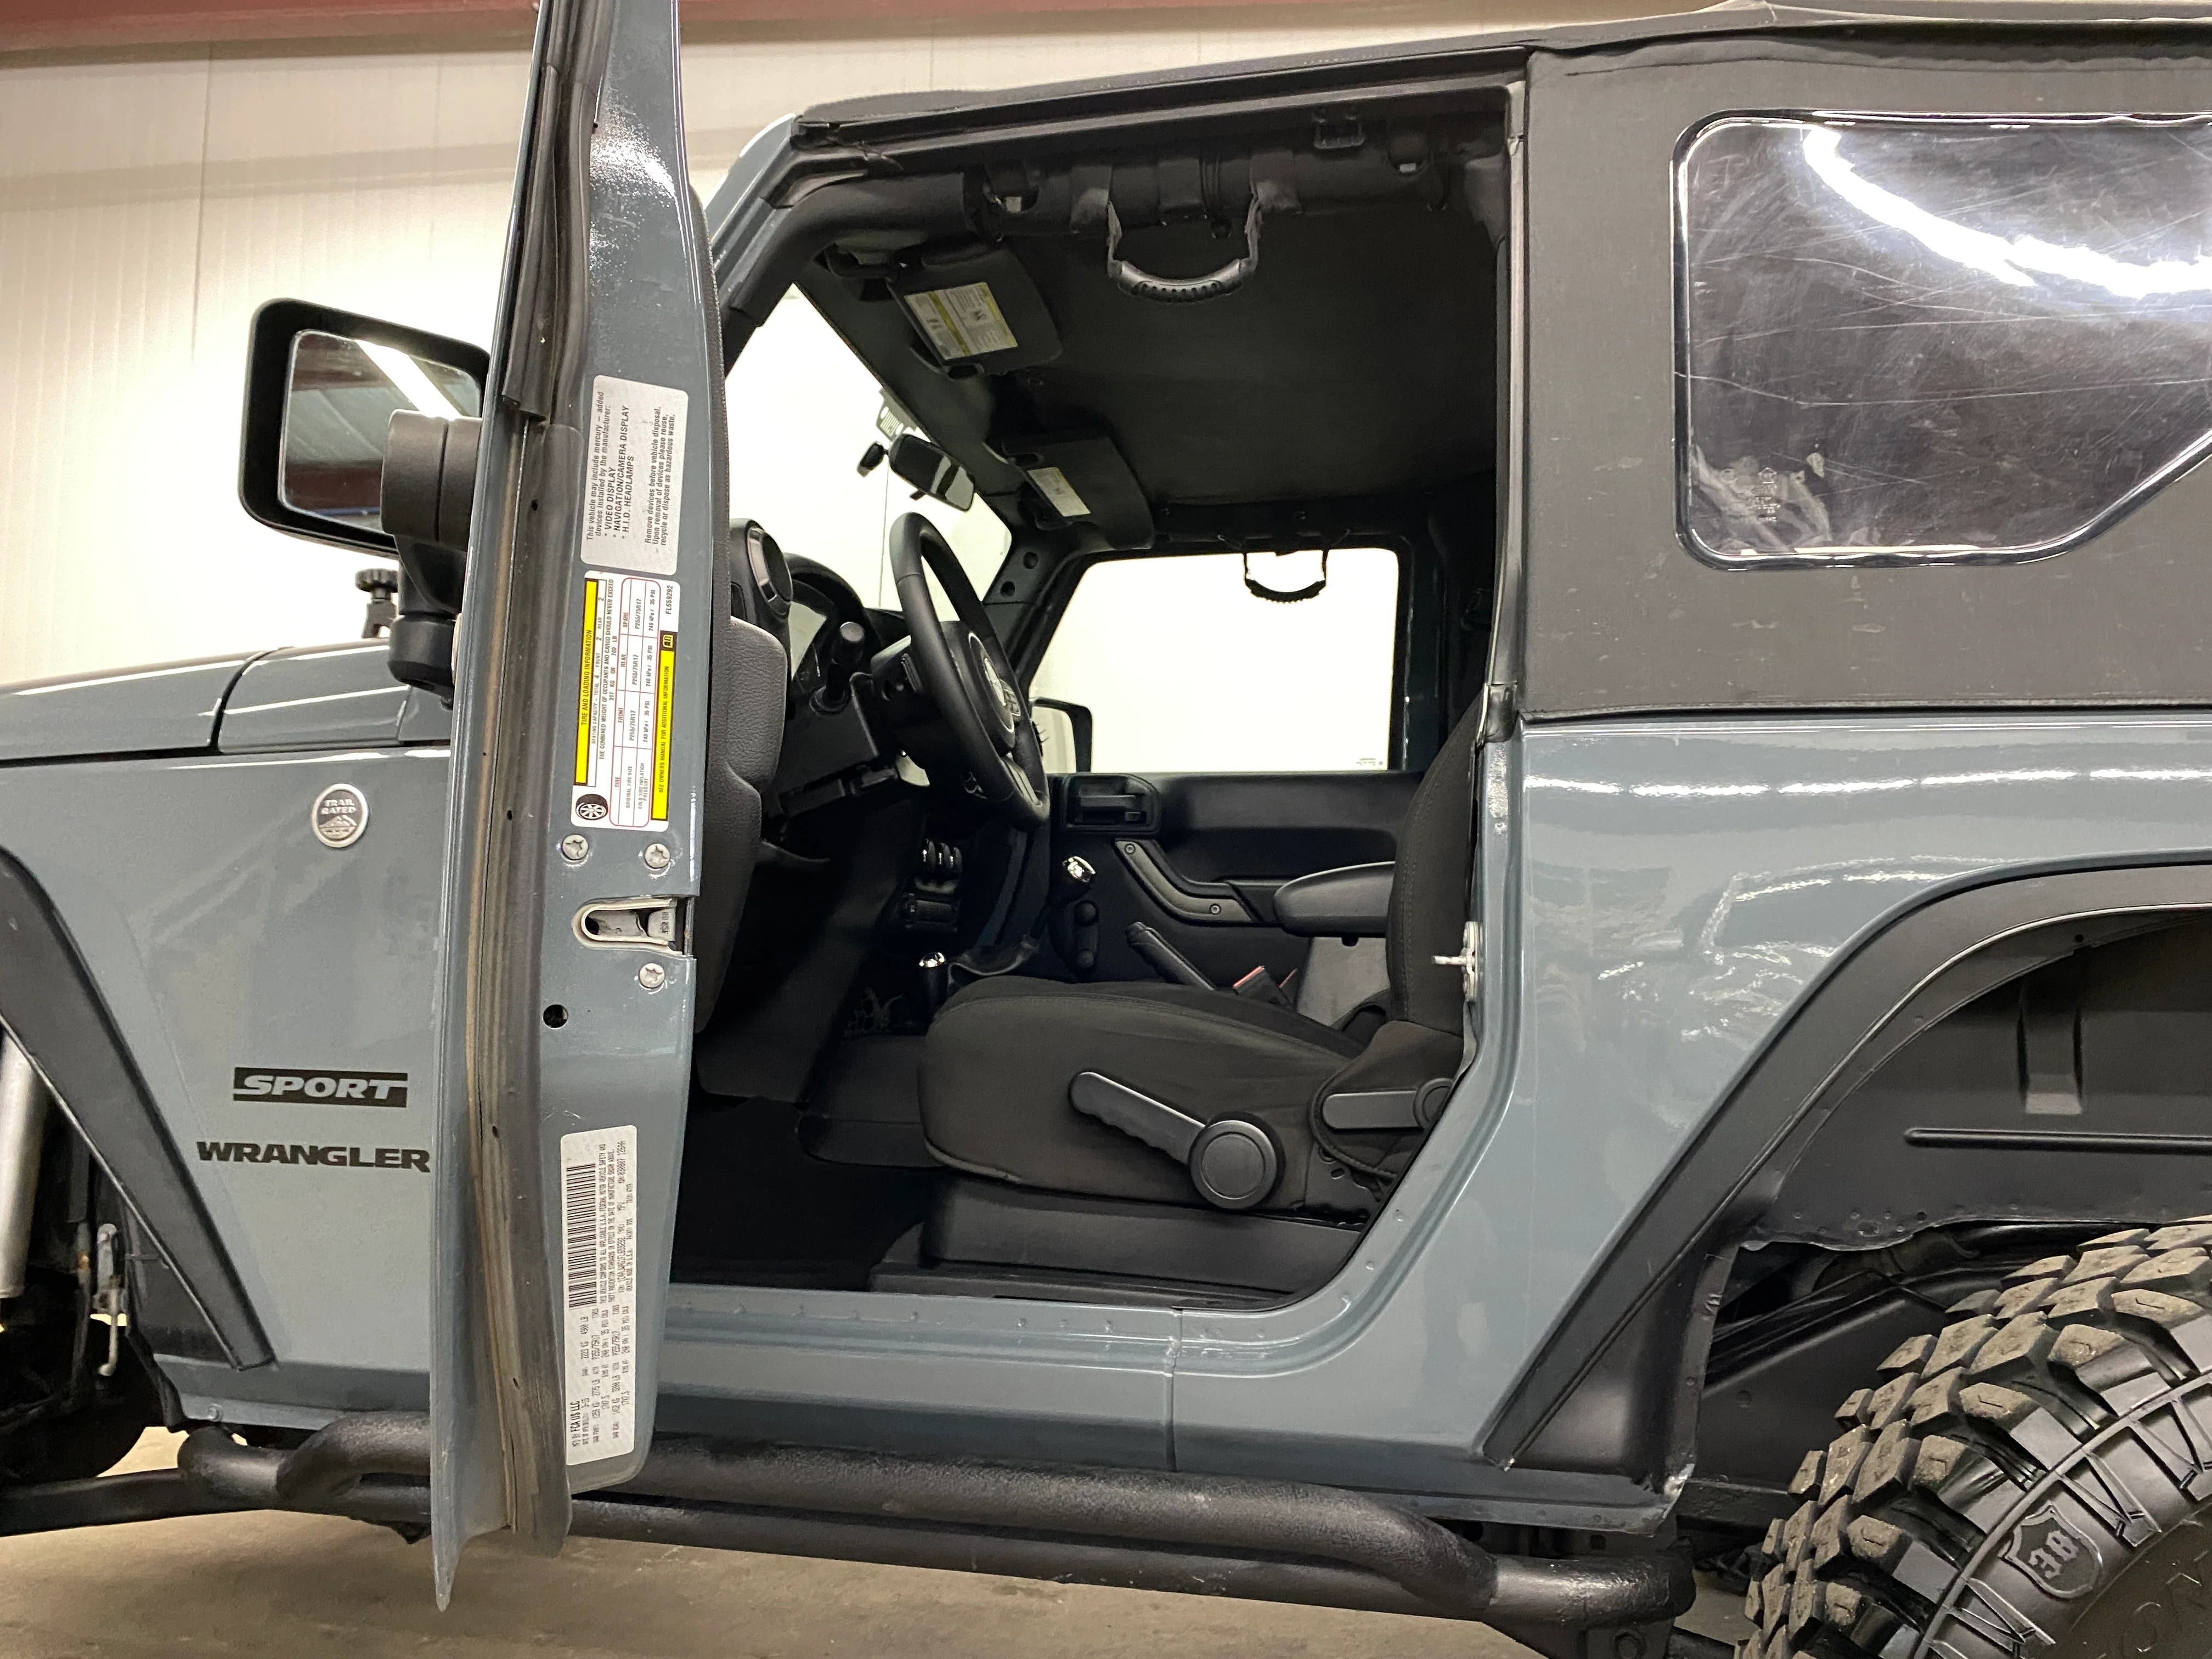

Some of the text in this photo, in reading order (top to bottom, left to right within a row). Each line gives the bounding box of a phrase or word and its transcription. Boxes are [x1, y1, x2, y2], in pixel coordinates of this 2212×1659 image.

[596, 391, 604, 413] added
[594, 424, 603, 453] mercury
[600, 404, 611, 453] manufacturer:
[658, 437, 668, 460] please
[664, 437, 674, 472] hazardous
[590, 454, 600, 481] include
[599, 467, 607, 477] by
[613, 405, 630, 531] NAVIGATION/CAMERA DISPLAY
[644, 405, 662, 543] Remove devices before vehicle disposal.
[656, 461, 664, 487] devices
[665, 473, 671, 482] as
[590, 482, 599, 497] may
[596, 478, 605, 508] installed
[604, 466, 616, 530] VIDEO DISPLAY
[622, 455, 634, 532] H.I.D. HEADLAMPS
[655, 488, 663, 496] of
[662, 484, 672, 511] dispose
[587, 499, 596, 524] vehicle
[594, 510, 603, 536] devices
[653, 497, 662, 525] removal
[586, 525, 594, 540] This
[652, 526, 661, 545] Upon
[659, 521, 669, 545] recycle
[584, 629, 592, 669] INFORMATION
[321, 806, 356, 815] RATED
[234, 1073, 408, 1102] SPORT
[196, 1141, 431, 1173] WRANGLER
[2028, 1530, 2079, 1579] 38
